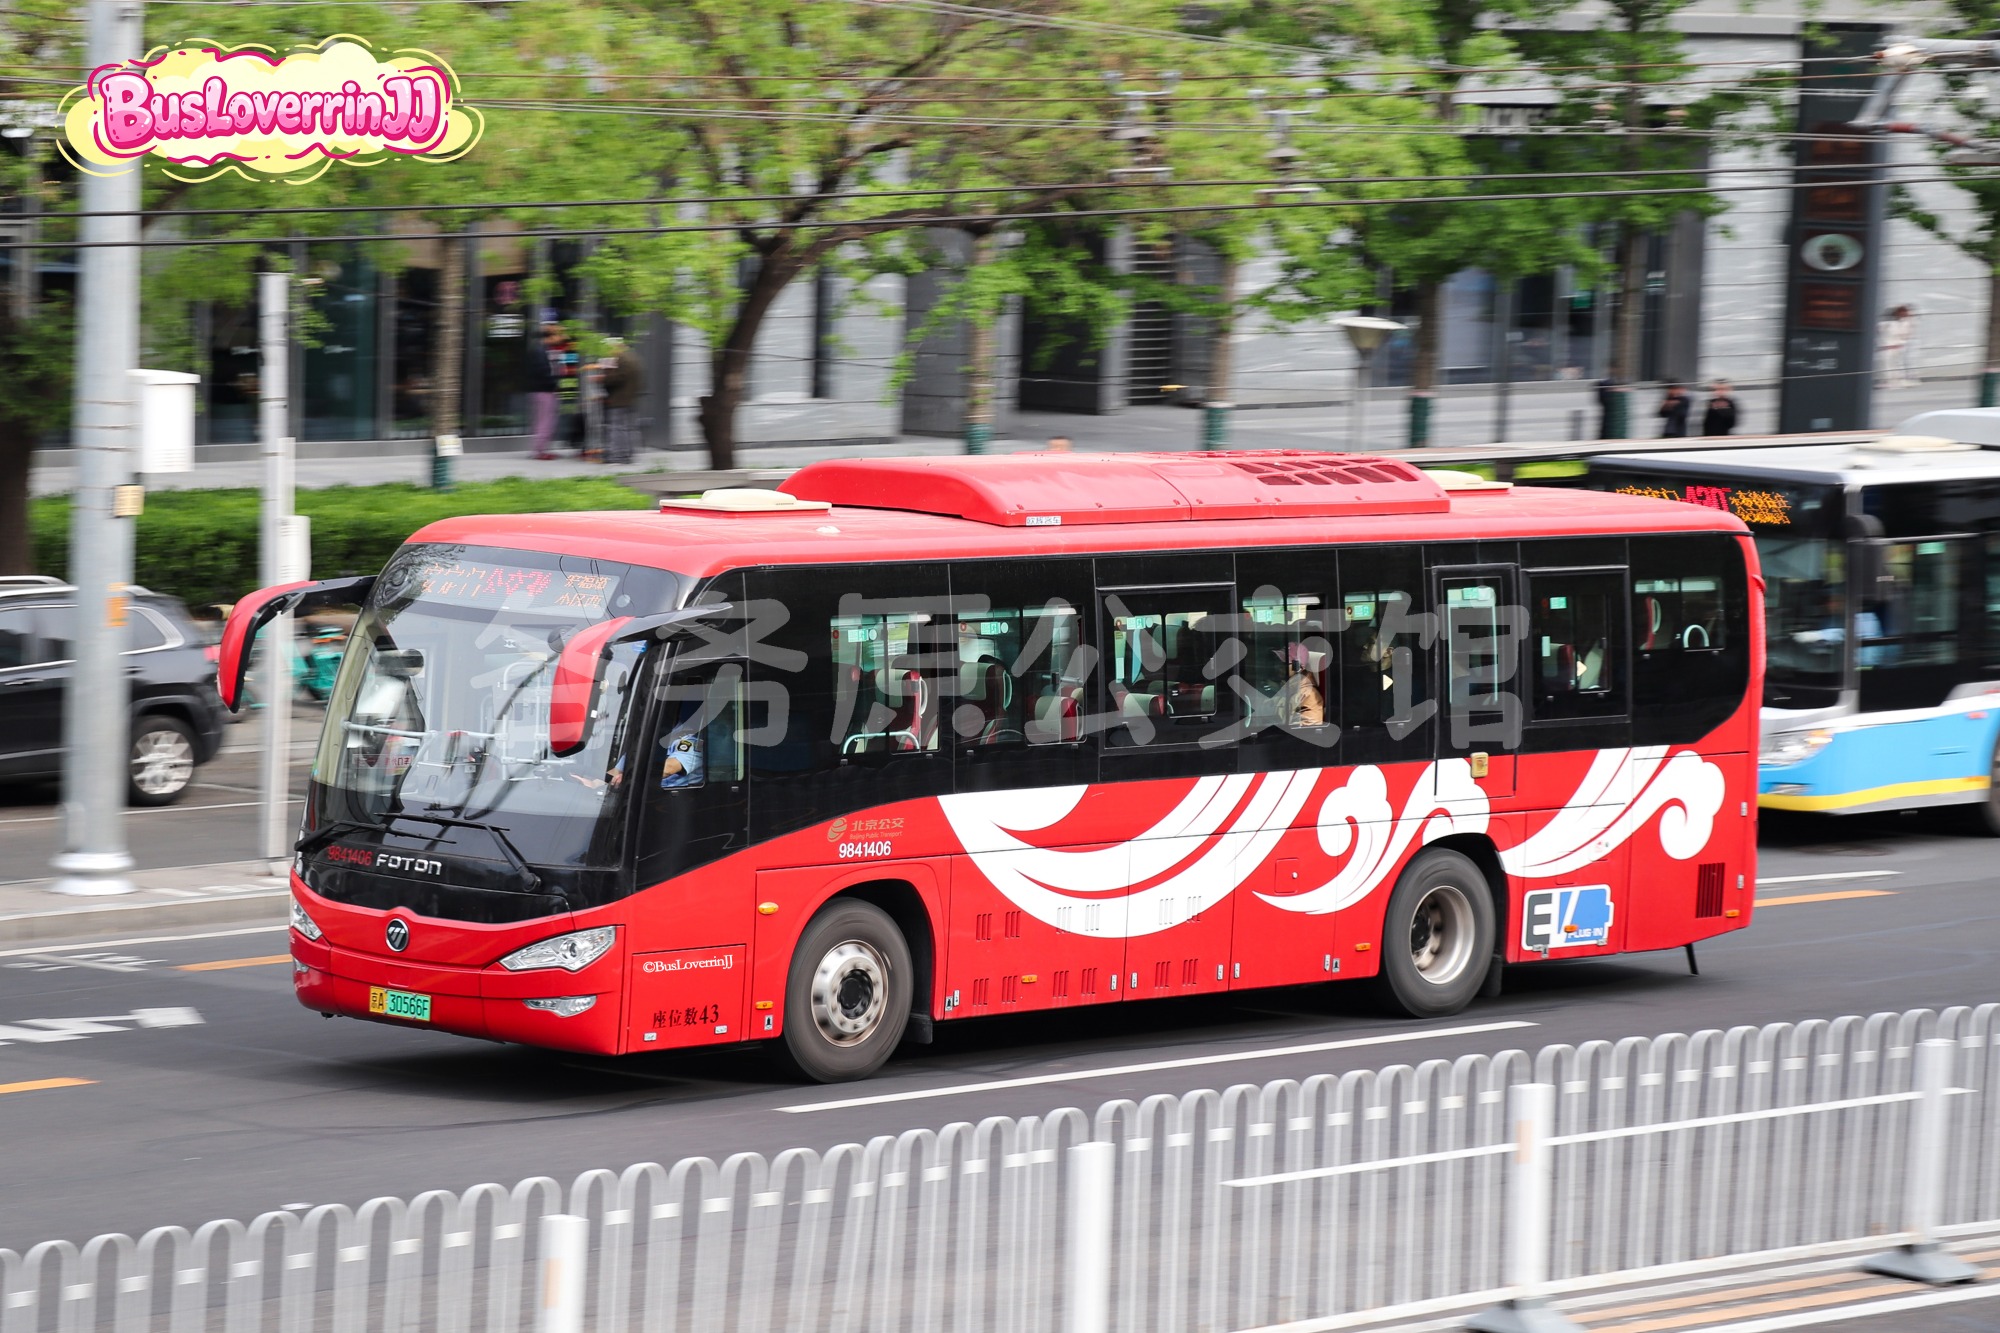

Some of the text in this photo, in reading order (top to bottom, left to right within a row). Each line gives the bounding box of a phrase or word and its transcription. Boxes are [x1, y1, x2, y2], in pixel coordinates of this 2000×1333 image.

[851, 818, 904, 831] 北京公交
[327, 845, 373, 866] 9841406
[838, 840, 892, 858] 9841406
[376, 853, 442, 875] FOTON
